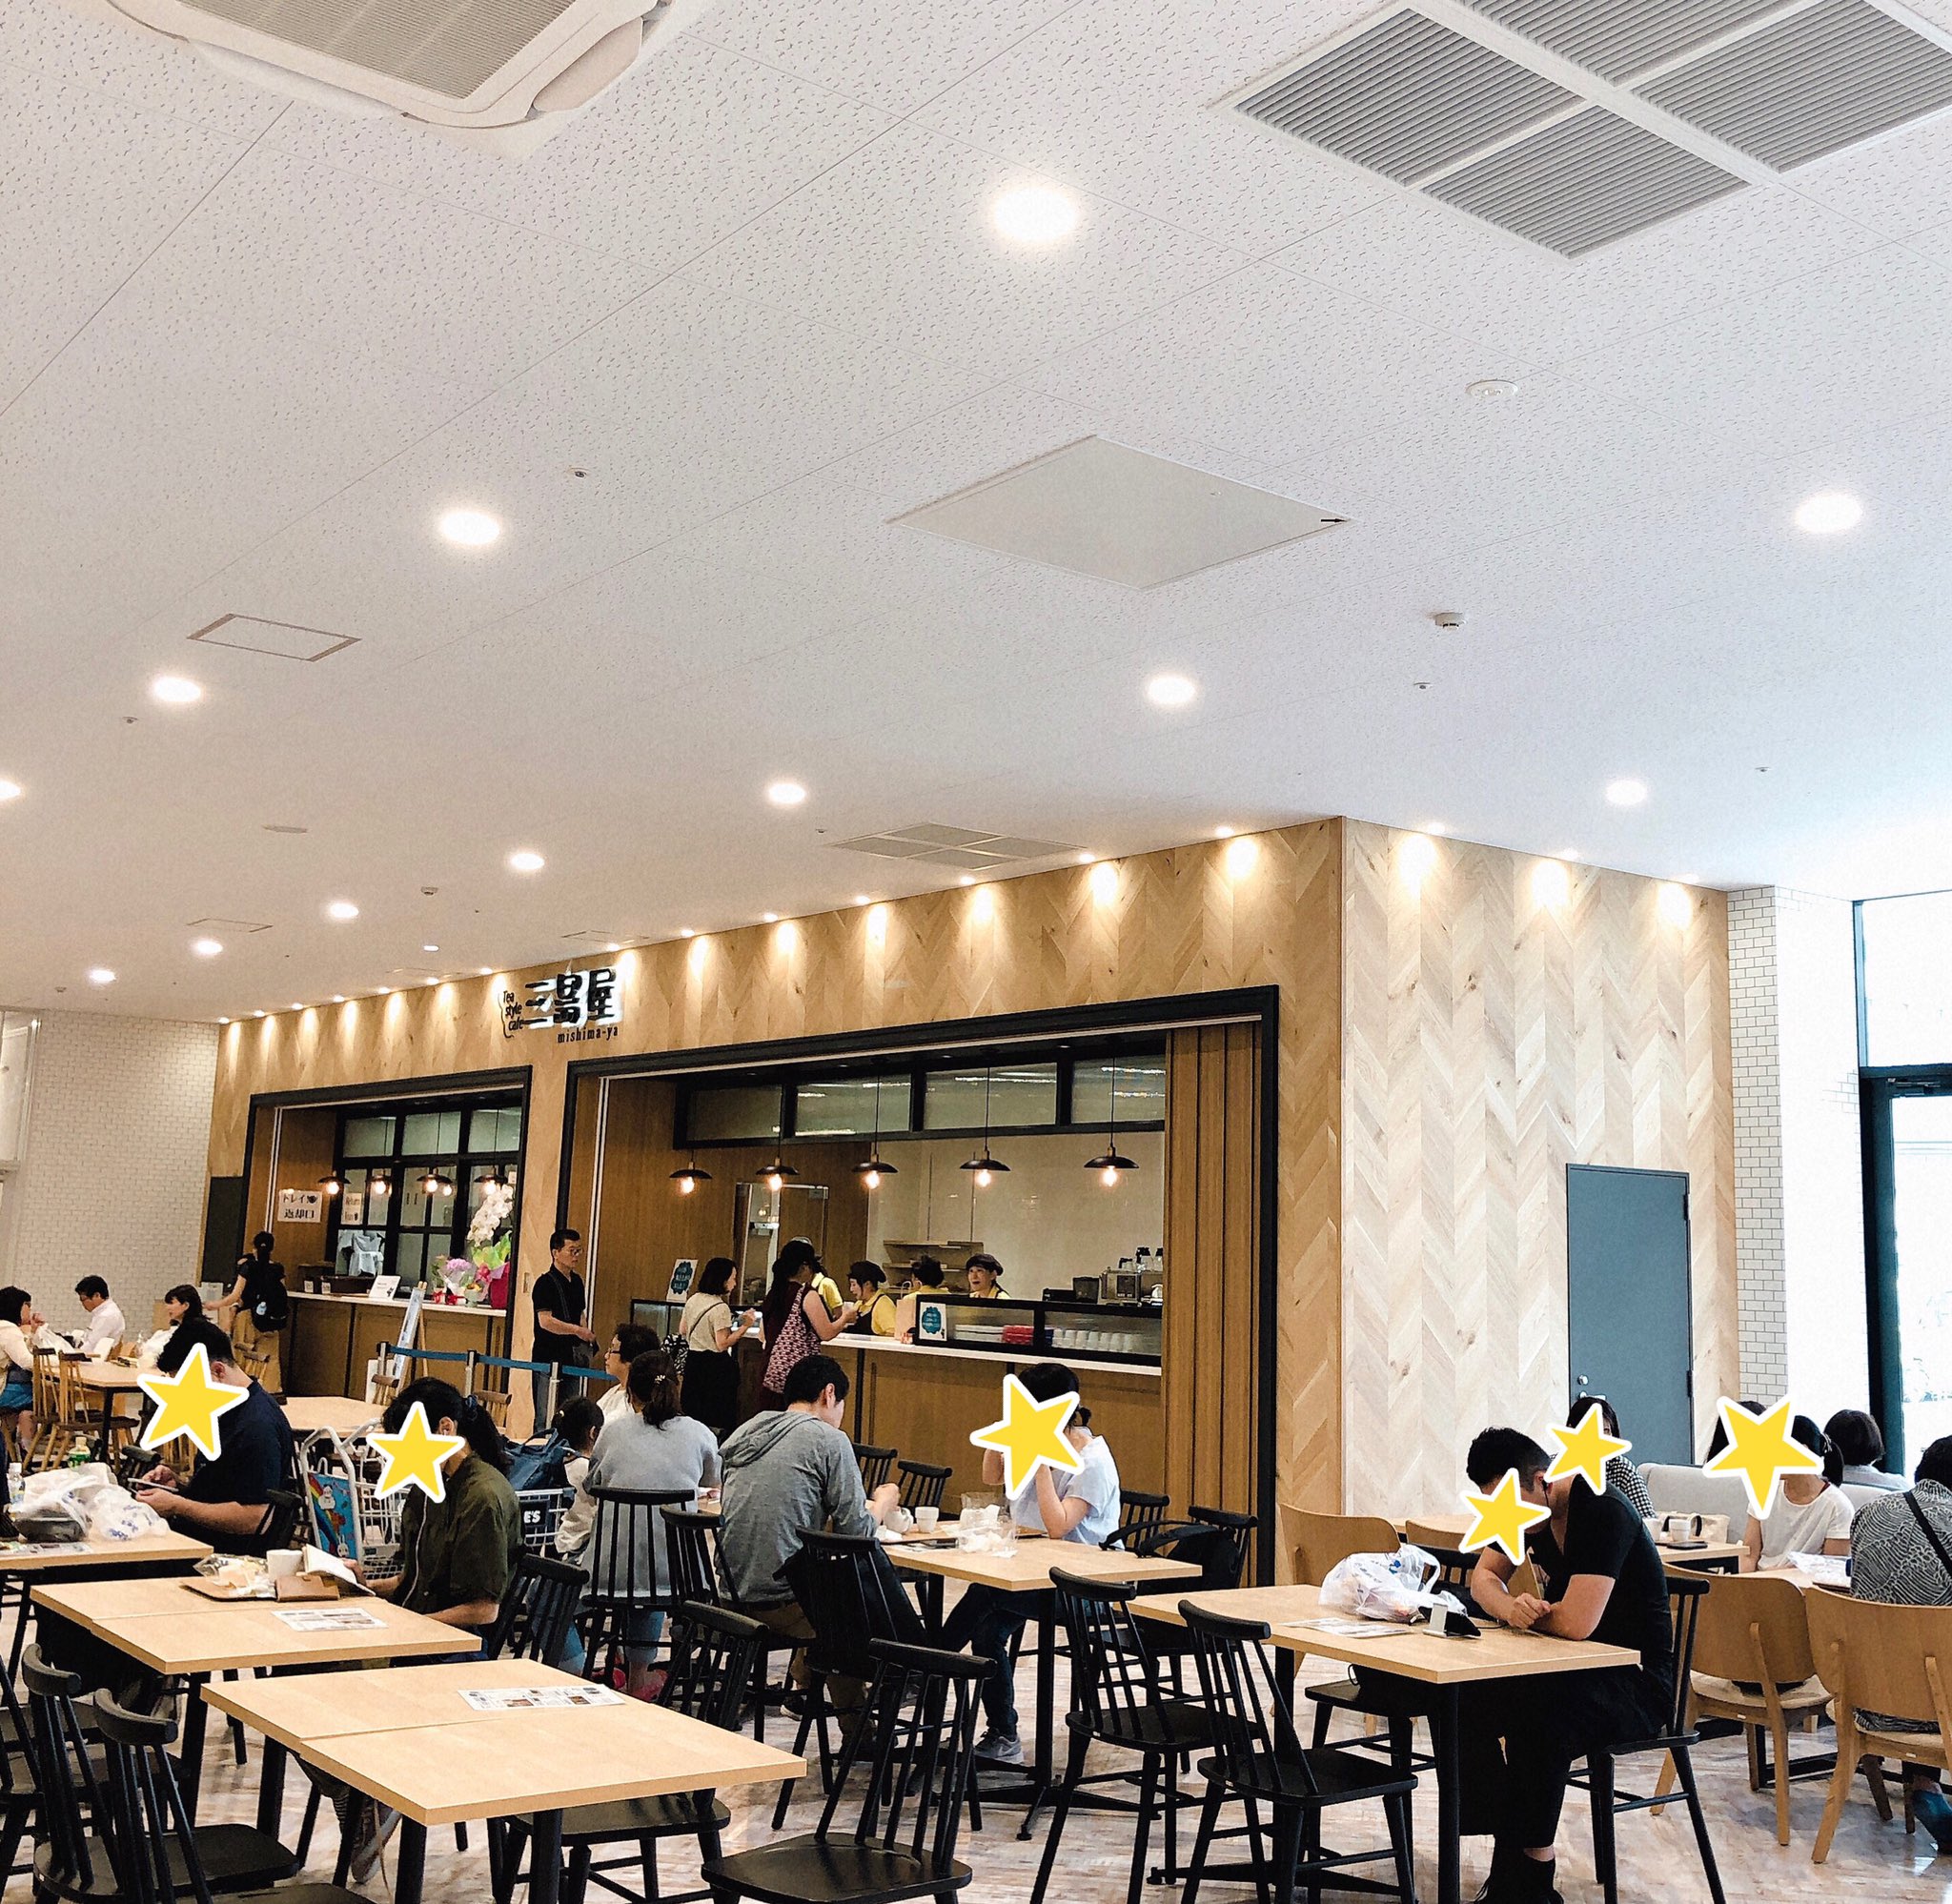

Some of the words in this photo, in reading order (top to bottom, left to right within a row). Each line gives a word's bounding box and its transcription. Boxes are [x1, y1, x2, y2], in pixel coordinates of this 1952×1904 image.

[502, 990, 515, 1003] Tea
[524, 968, 616, 1024] 三島屋
[505, 1003, 523, 1019] style
[558, 1025, 619, 1043] mishima-ya
[284, 1208, 315, 1219] 返却口
